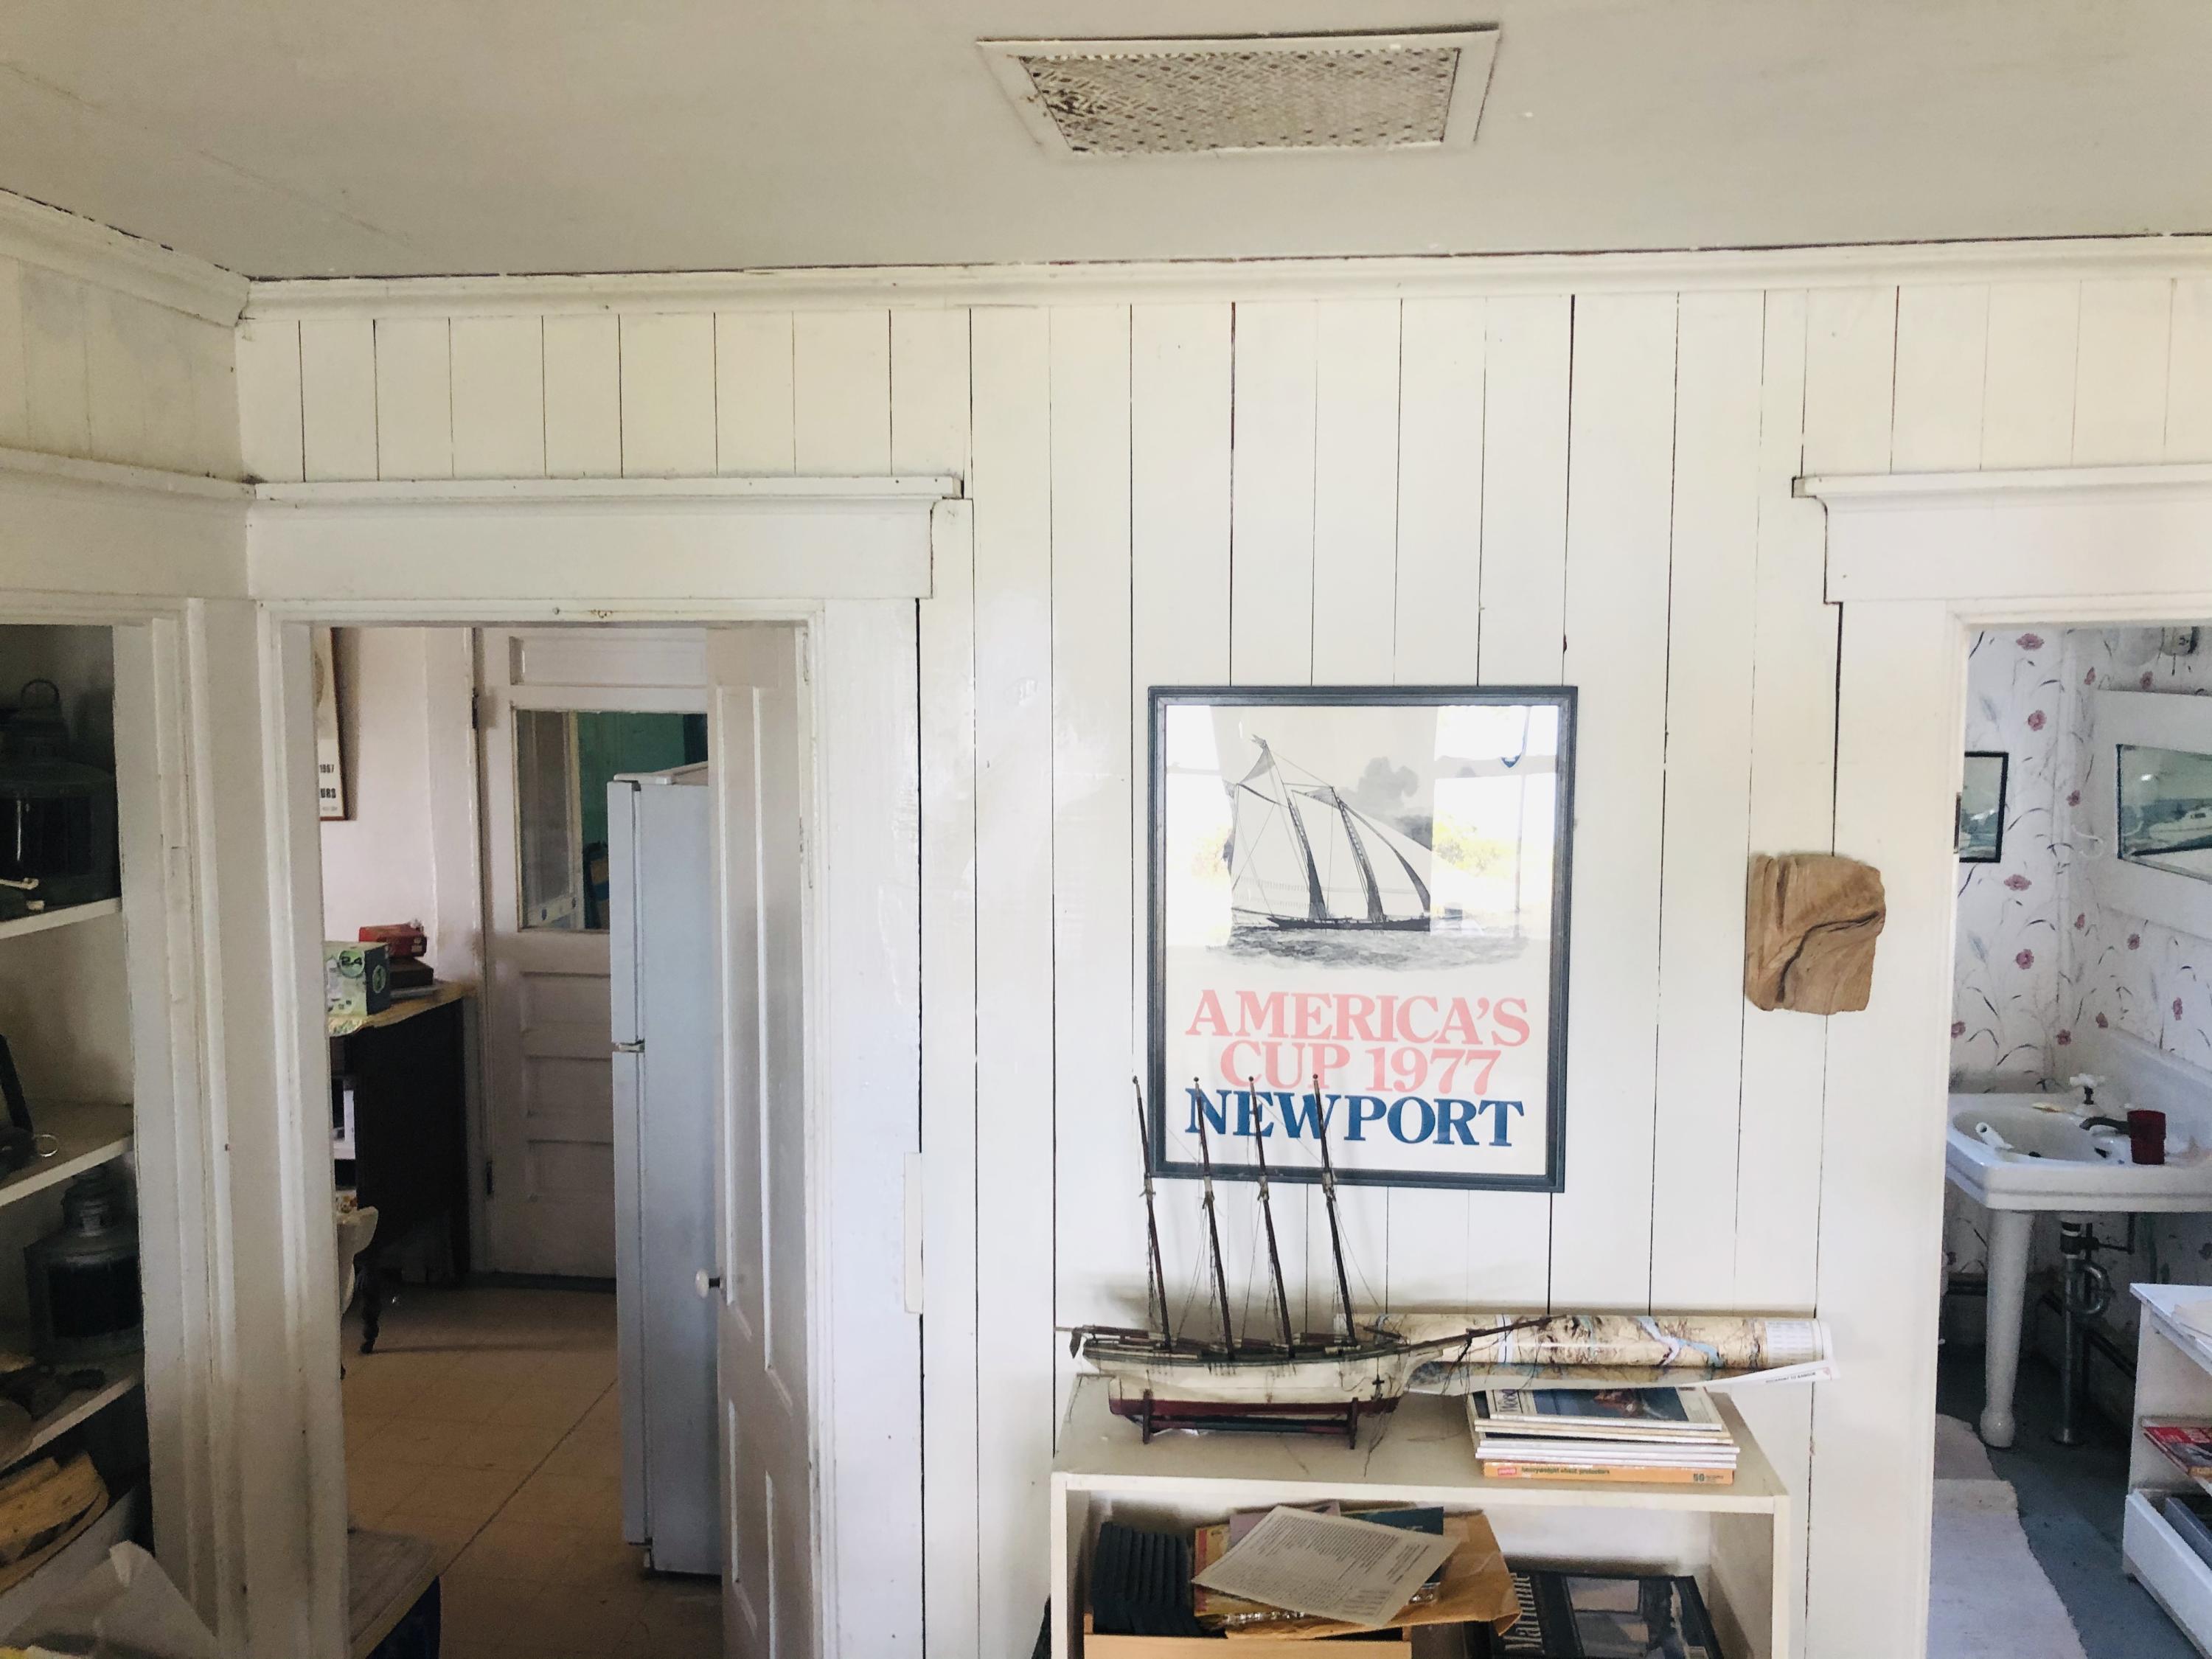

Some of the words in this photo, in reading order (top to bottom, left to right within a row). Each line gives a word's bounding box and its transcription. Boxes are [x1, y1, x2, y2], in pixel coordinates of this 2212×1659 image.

[1185, 989, 1531, 1047] AMERICA'S
[1220, 1039, 1351, 1090] CUP
[1364, 1046, 1502, 1096] 1977
[1184, 1087, 1525, 1147] NEWPORT
